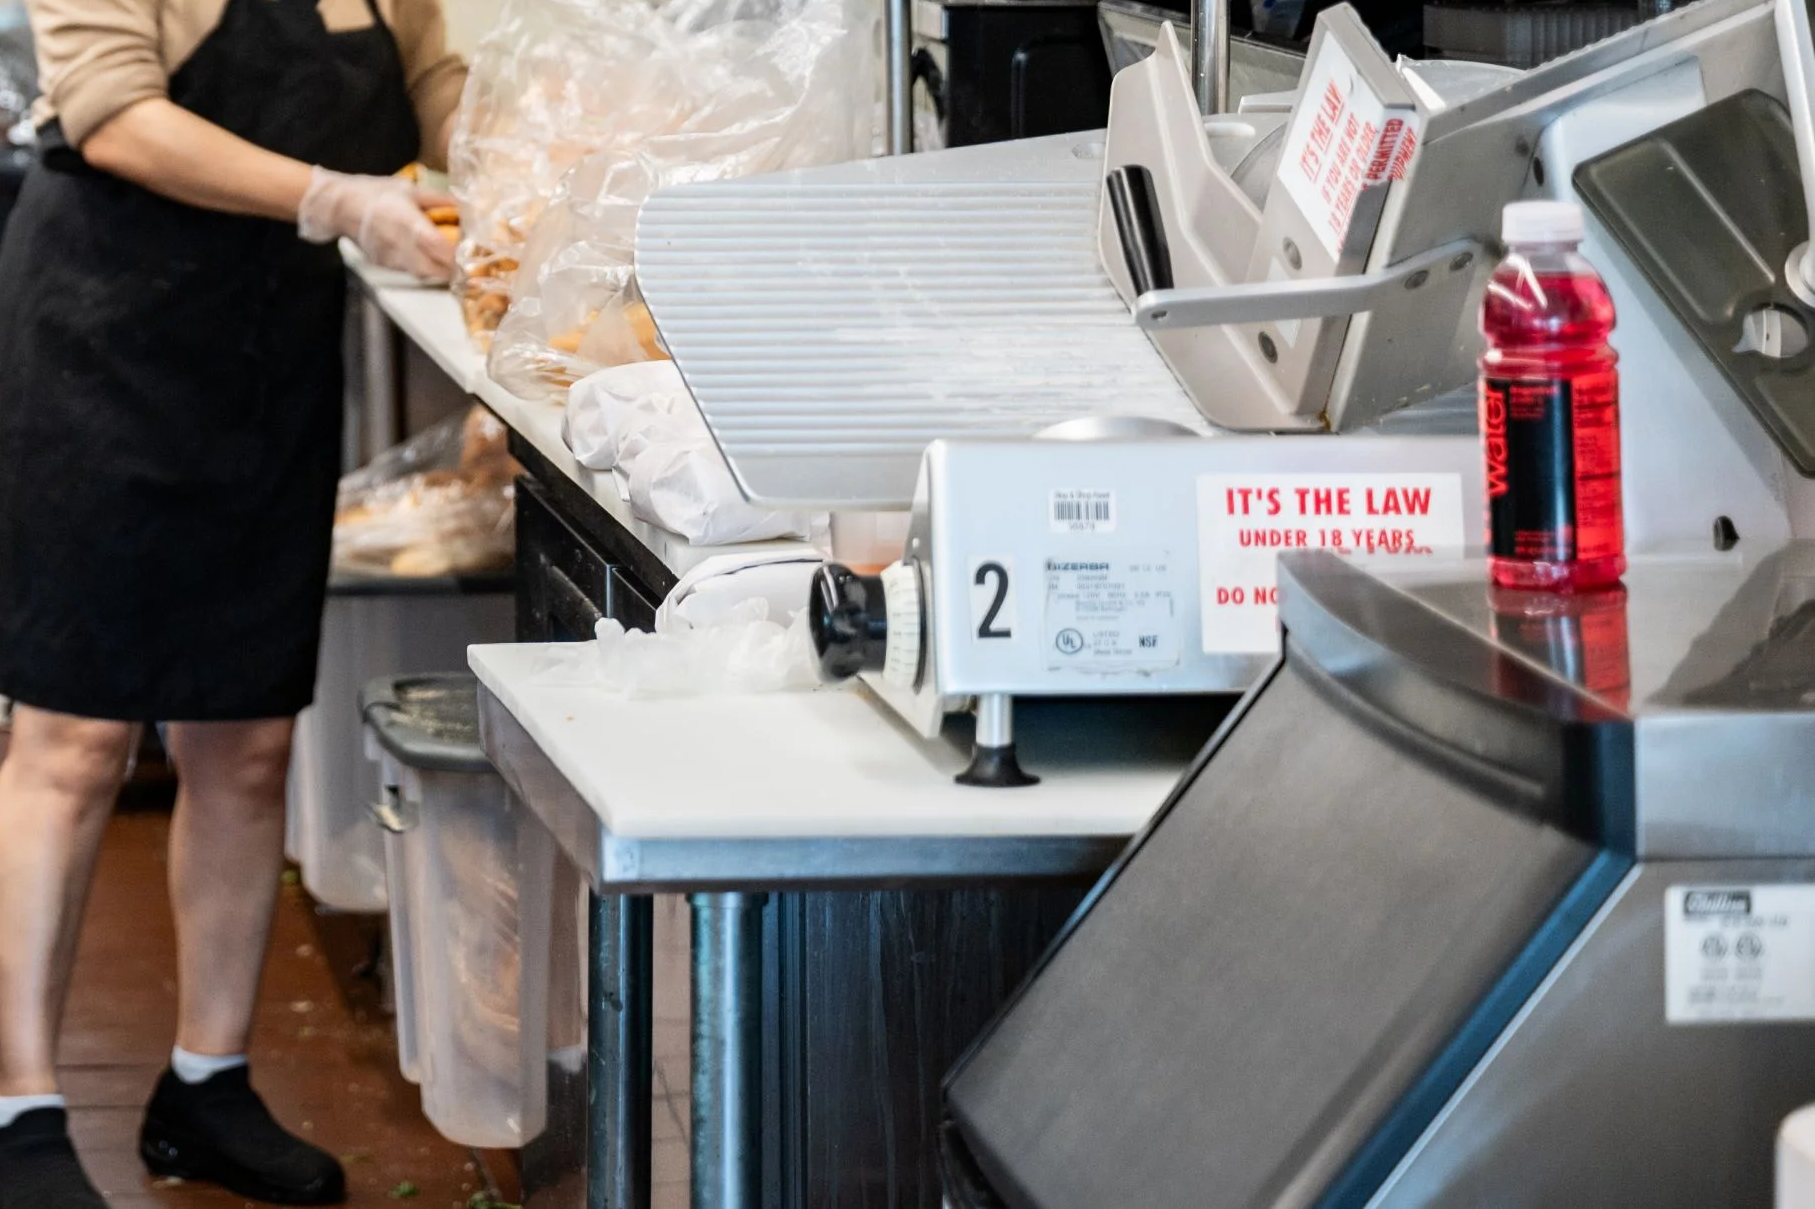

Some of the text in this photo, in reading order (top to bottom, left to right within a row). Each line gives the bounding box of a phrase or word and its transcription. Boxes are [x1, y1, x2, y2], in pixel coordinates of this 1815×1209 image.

[1299, 144, 1318, 180] IT'S
[1310, 114, 1331, 153] THE
[1326, 165, 1341, 189] YOU
[1336, 138, 1351, 165] ARE
[1345, 112, 1360, 139] NOT
[1366, 118, 1404, 180] PERMITTED
[1335, 176, 1354, 215] YEARS
[1349, 158, 1362, 183] OR
[1226, 487, 1432, 515] IT'S THE LAW
[1239, 529, 1415, 547] UNDER 18 YEARS
[974, 561, 1011, 638] 2
[1217, 587, 1245, 605] DO
[1139, 635, 1159, 648] NSF
